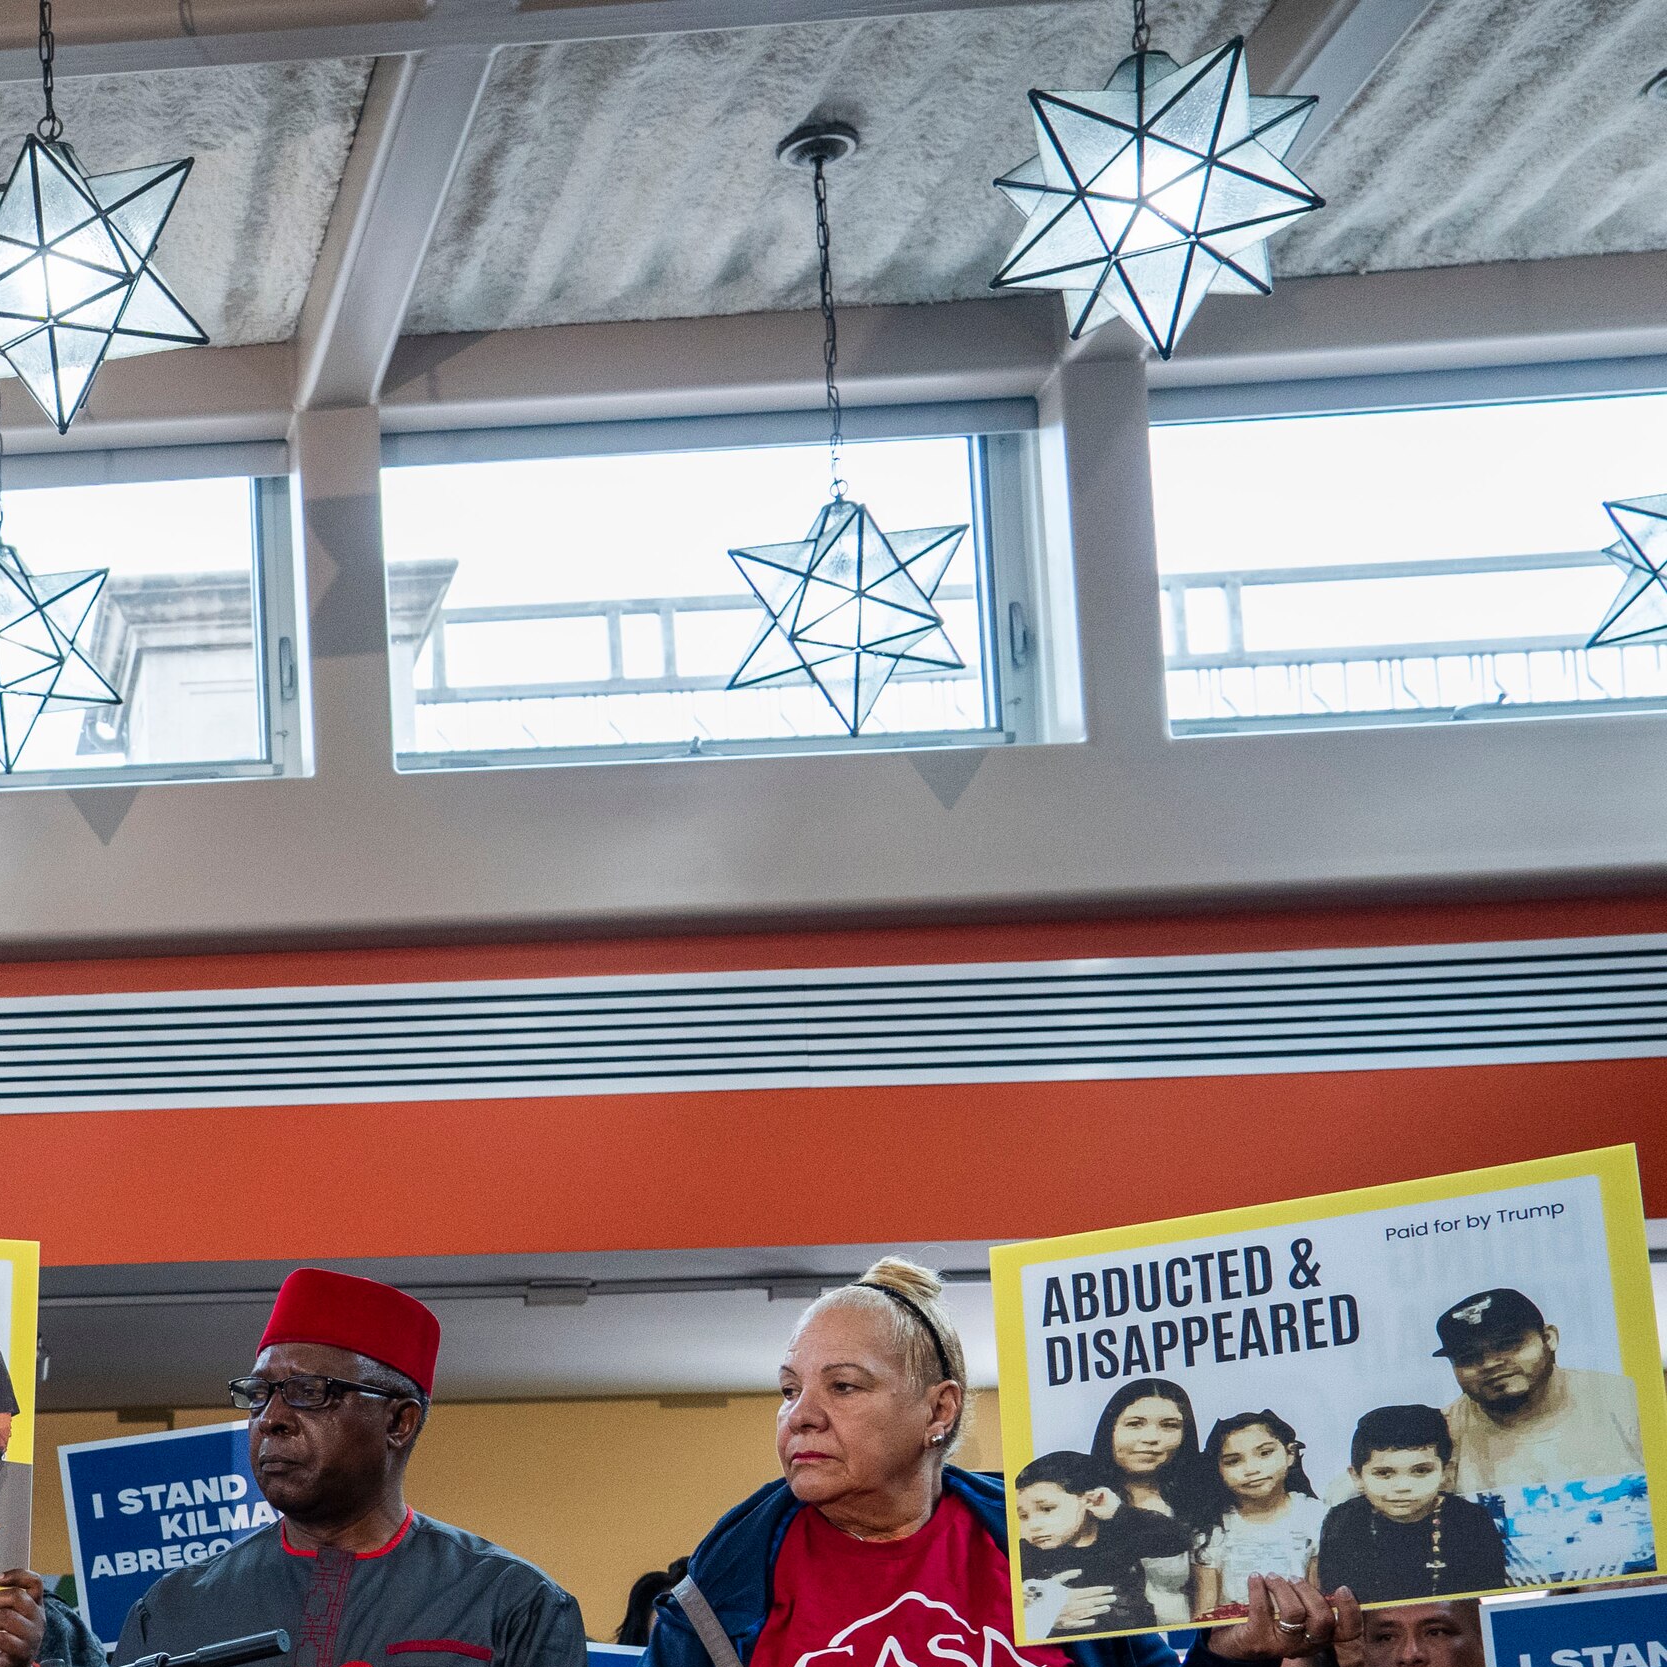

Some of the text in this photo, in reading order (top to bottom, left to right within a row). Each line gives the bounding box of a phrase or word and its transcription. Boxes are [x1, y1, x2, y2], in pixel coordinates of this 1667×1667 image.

[1385, 1202, 1565, 1241] Paid for by Trump
[1042, 1238, 1322, 1327] ABDUCTED &
[1046, 1294, 1360, 1387] DISAPPEARED
[92, 1474, 247, 1519] I STAND
[159, 1501, 285, 1541] KILMA
